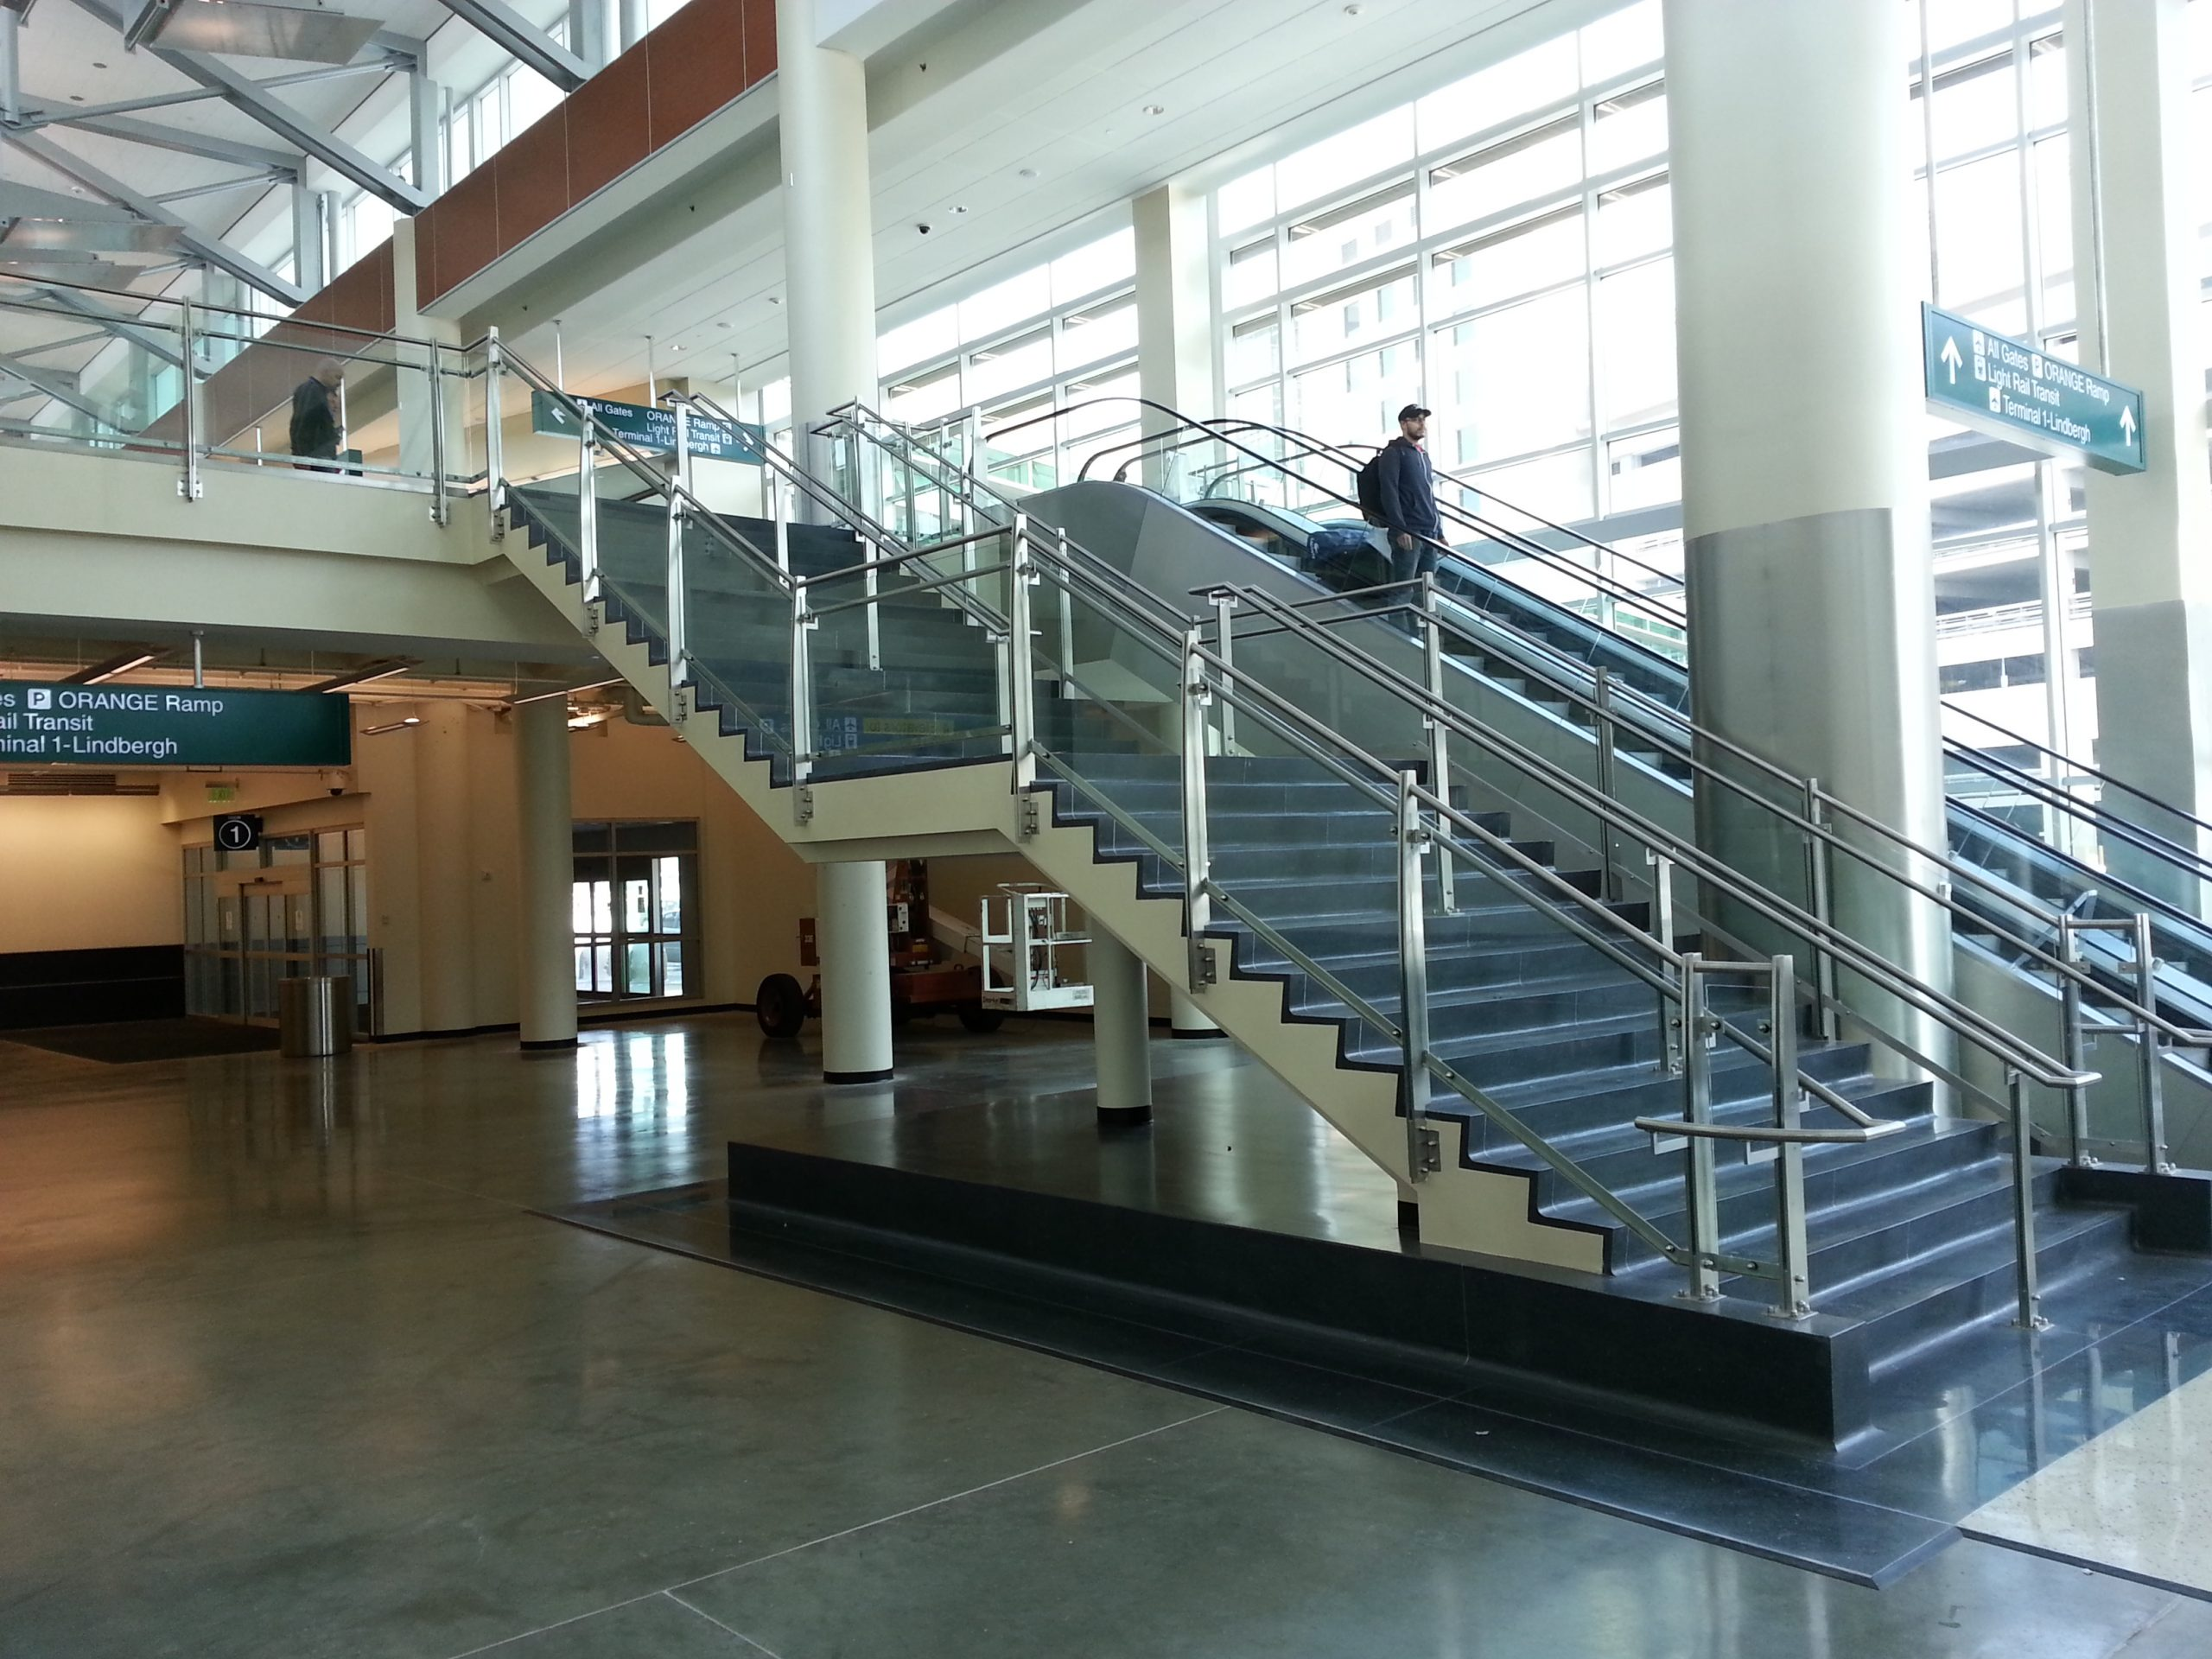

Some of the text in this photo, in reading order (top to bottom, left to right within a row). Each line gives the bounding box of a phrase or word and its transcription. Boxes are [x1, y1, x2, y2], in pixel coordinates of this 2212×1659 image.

[1987, 338, 1999, 359] All
[2001, 343, 2029, 372] Gates
[2044, 361, 2085, 393] ORANGE
[2086, 378, 2110, 406] Ramp
[1988, 362, 2060, 407] Light Rail Transit
[591, 402, 633, 418] All Gates
[646, 410, 721, 433] ORANE Ramp
[2002, 394, 2091, 444] Terminal 1-Lindbergh
[612, 427, 709, 453] Terminal 1-Linergh
[646, 423, 670, 436] Light
[690, 429, 721, 443] Transit
[59, 691, 159, 711] ORANGE
[166, 695, 224, 716] Ramp
[22, 712, 94, 732] Transit
[52, 735, 178, 760] 1-Lindbergh
[230, 825, 239, 843] 1
